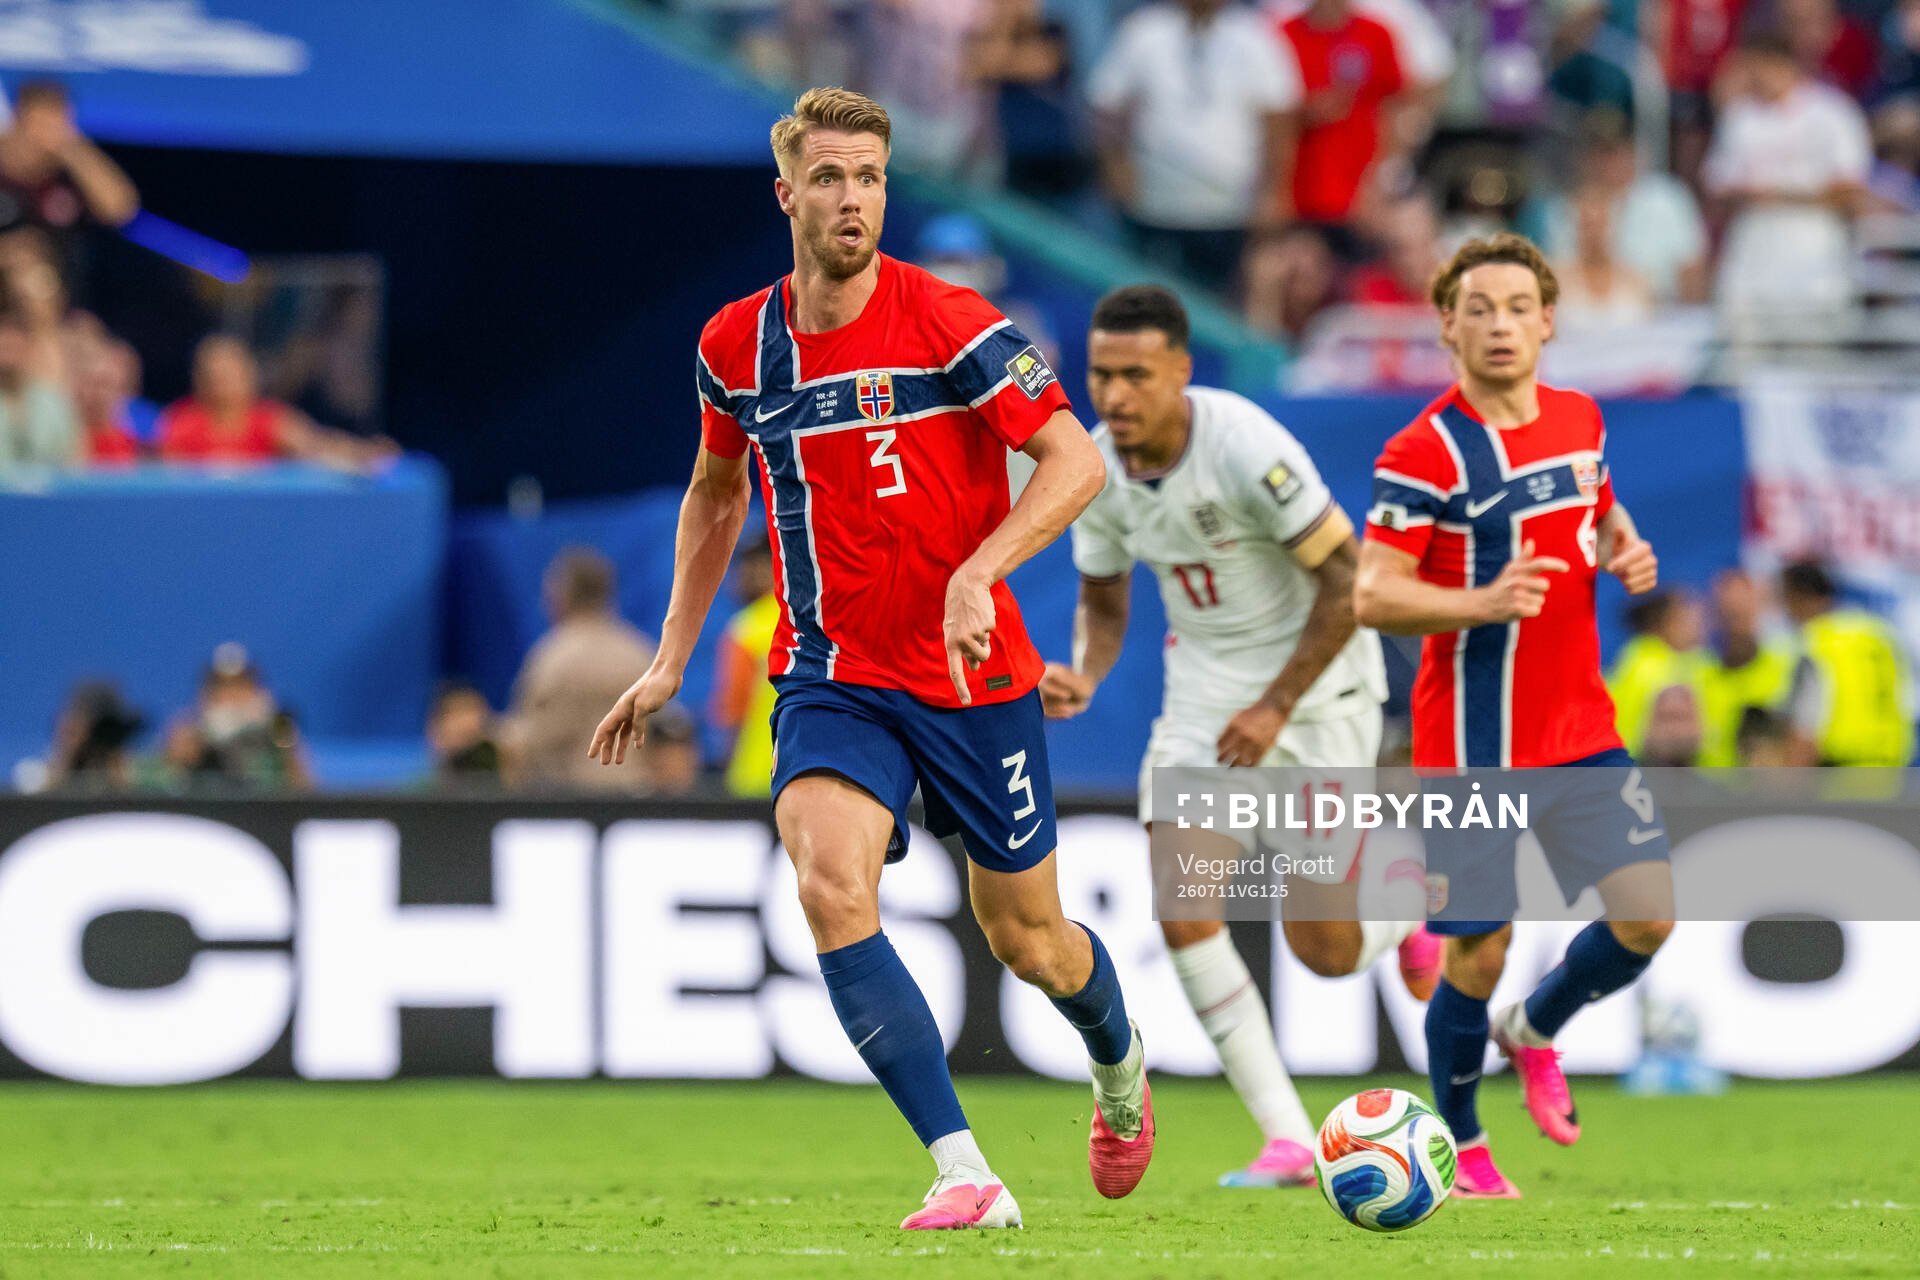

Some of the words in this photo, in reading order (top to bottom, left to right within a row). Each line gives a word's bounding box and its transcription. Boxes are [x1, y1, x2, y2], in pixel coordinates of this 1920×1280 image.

[865, 429, 908, 499] 3
[1576, 506, 1598, 568] 6
[1172, 560, 1219, 610] 17
[1001, 749, 1037, 821] 3
[1301, 781, 1343, 840] 17
[1620, 767, 1654, 823] 6
[0, 811, 966, 1085] CHES
